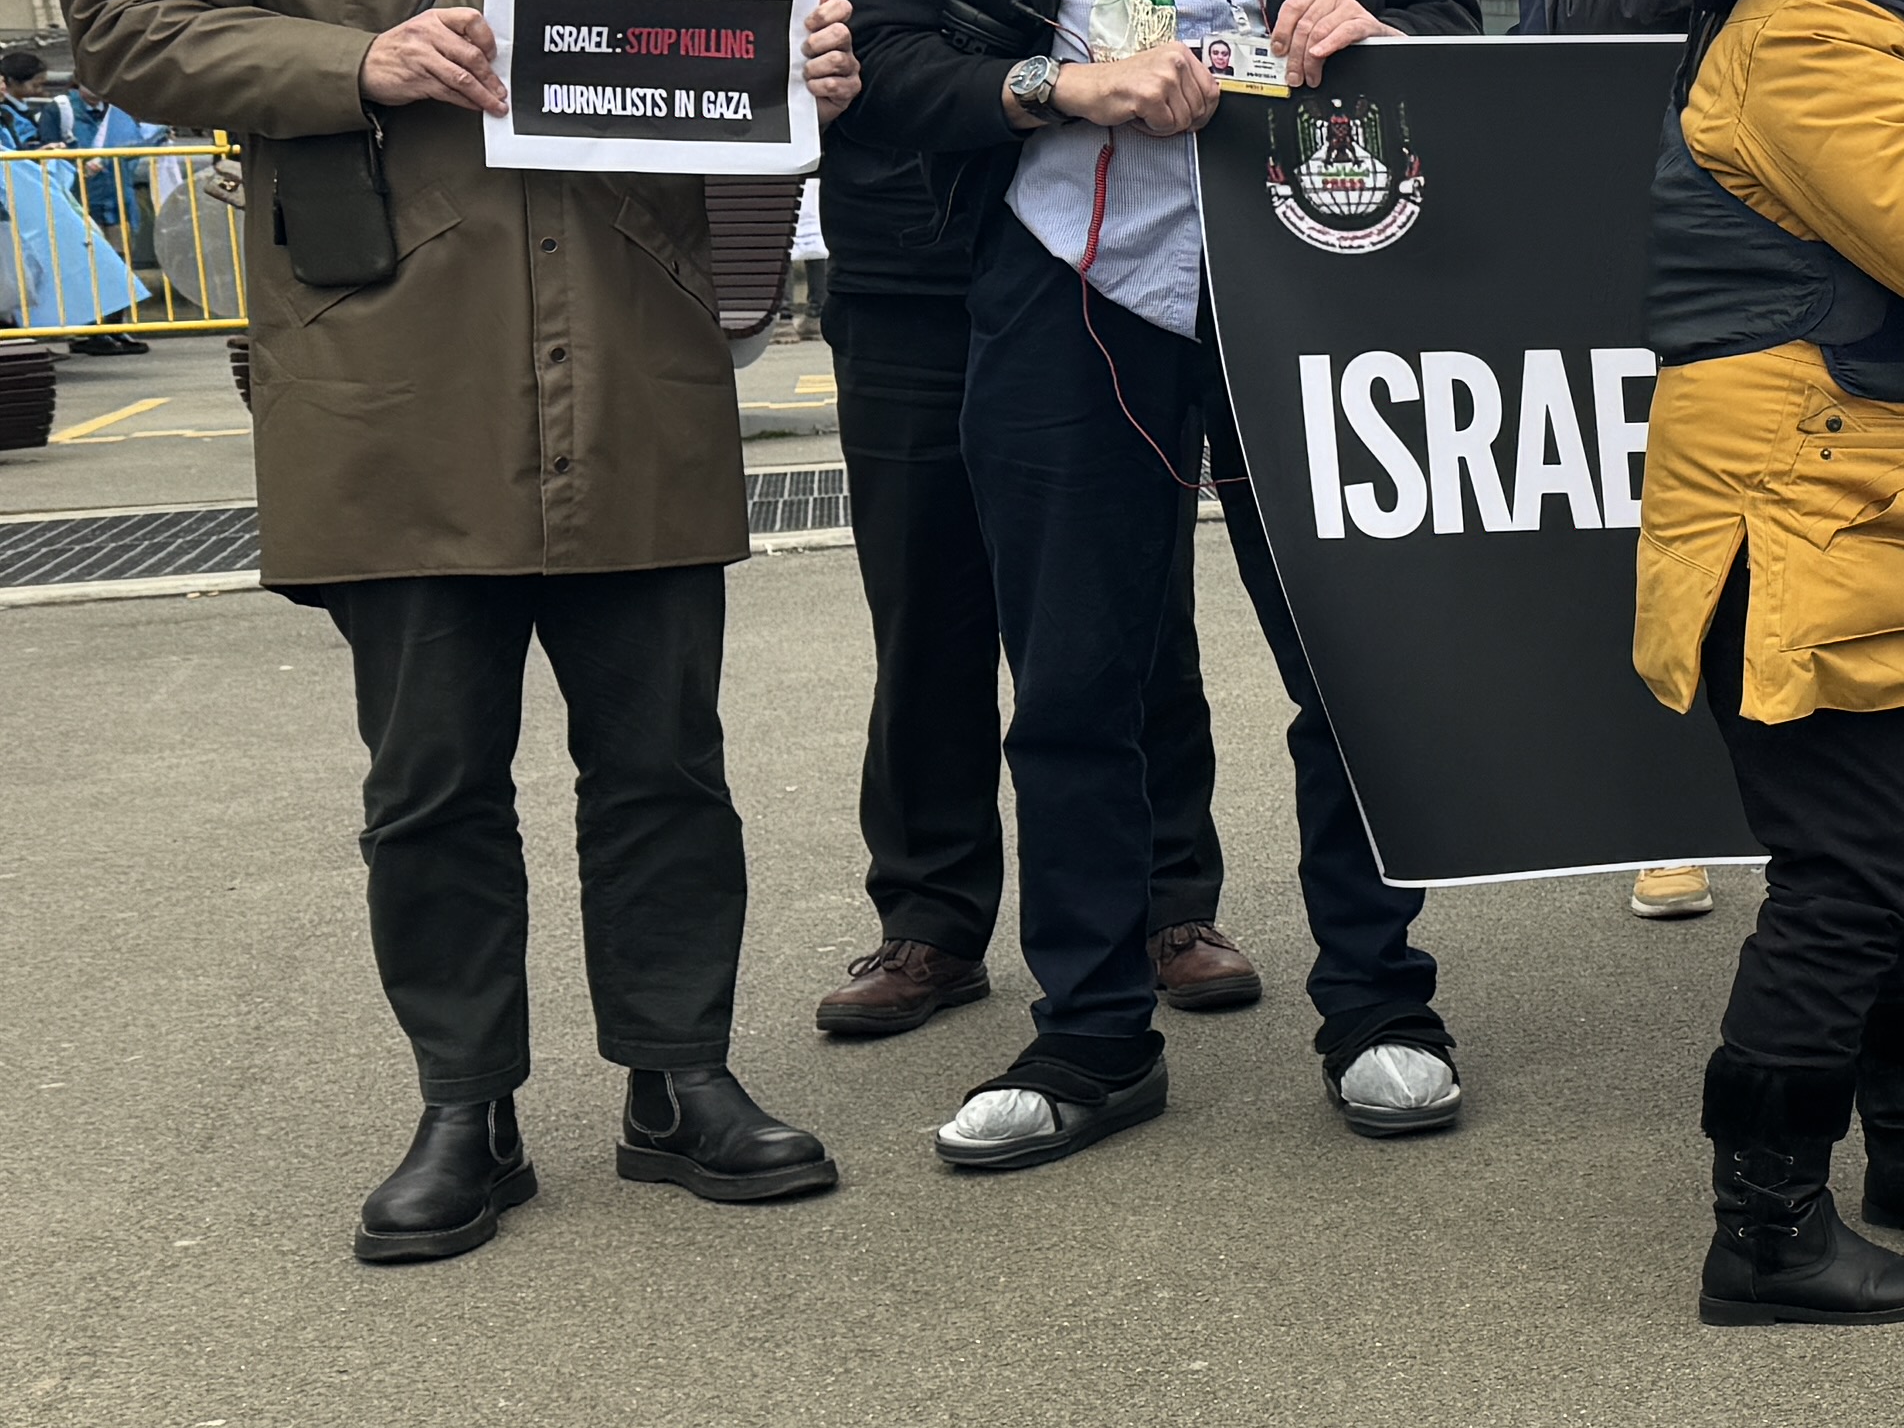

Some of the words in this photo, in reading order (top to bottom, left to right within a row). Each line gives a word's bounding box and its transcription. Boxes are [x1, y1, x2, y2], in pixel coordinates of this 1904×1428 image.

[625, 28, 678, 55] STOP
[679, 28, 755, 59] KILLING
[541, 83, 668, 118] JOURNALISTS
[674, 88, 695, 118] IN
[702, 90, 752, 120] GAZA
[1298, 347, 1657, 540] ISRAE
